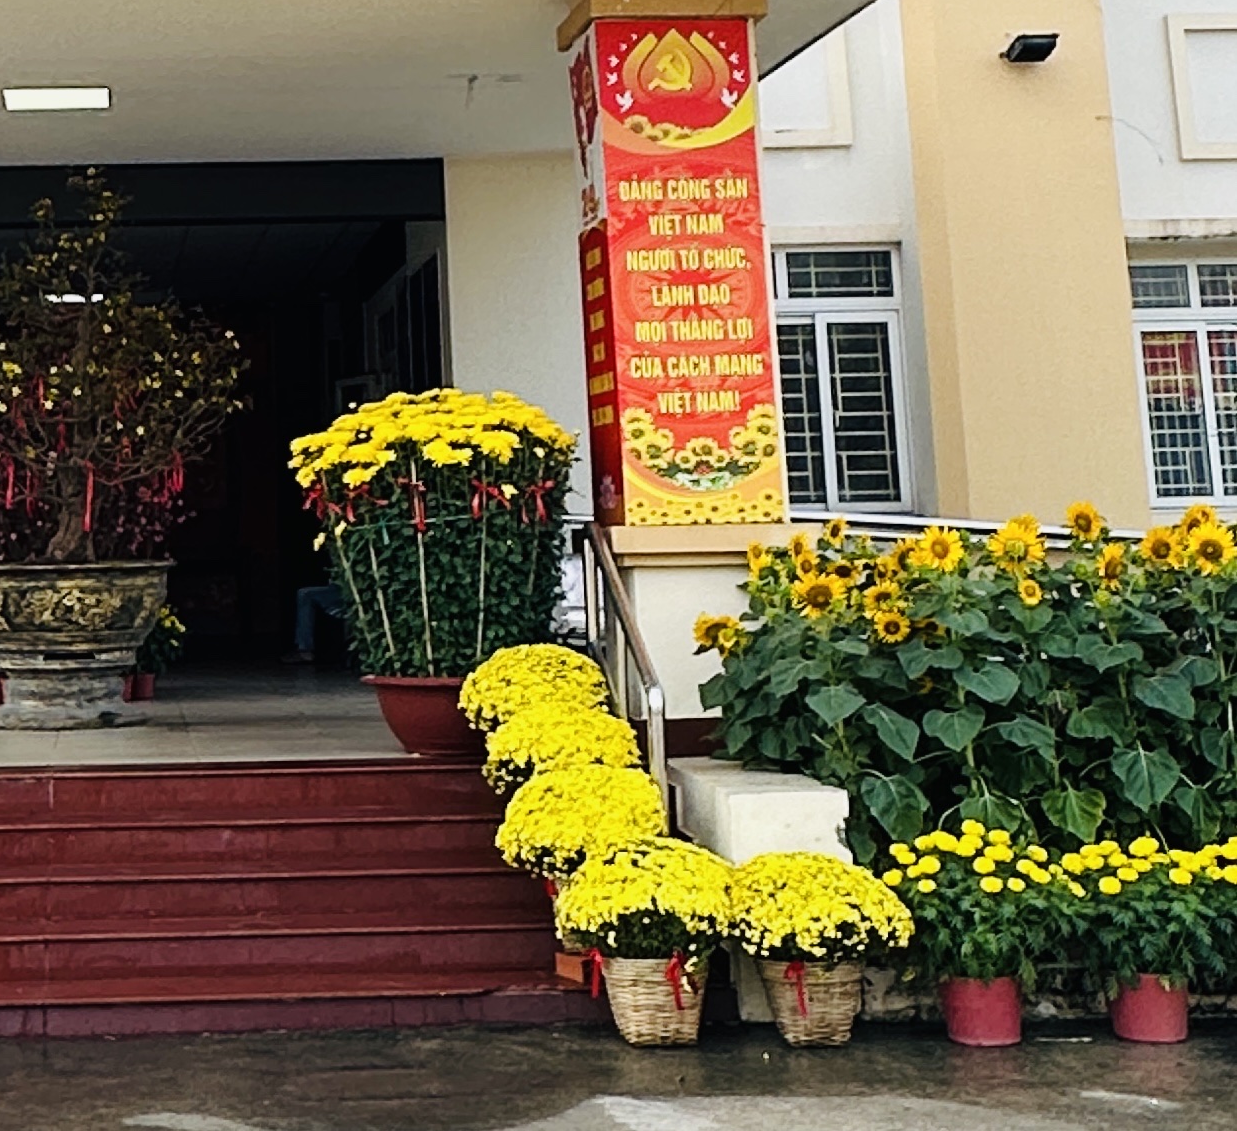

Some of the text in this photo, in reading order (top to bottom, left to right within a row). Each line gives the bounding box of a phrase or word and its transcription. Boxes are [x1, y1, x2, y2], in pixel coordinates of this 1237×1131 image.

[648, 212, 724, 241] VIỆT NAM
[630, 350, 664, 378] CỦA
[657, 387, 742, 418] VIỆT NAM!
